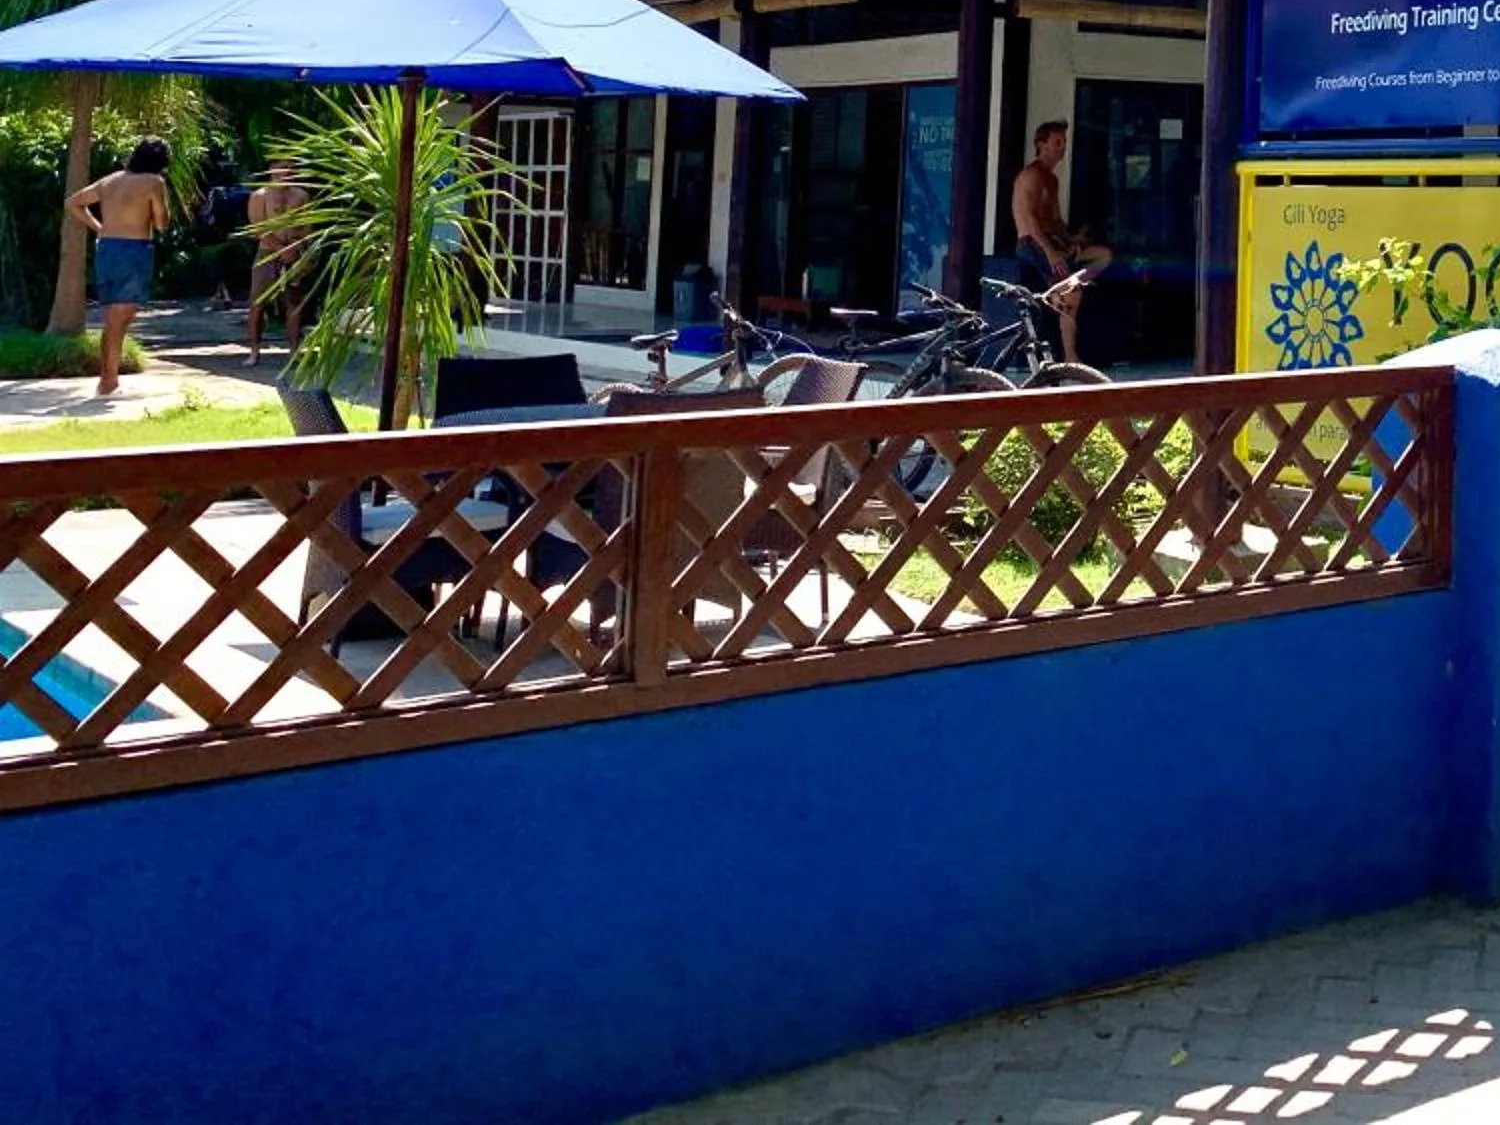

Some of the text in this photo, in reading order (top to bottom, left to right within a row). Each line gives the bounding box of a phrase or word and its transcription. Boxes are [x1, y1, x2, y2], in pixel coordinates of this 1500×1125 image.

[1331, 7, 1408, 36] Freediving
[1411, 1, 1480, 30] Training
[1315, 75, 1367, 92] Freediving
[1368, 72, 1407, 87] Courses
[1409, 70, 1434, 84] from
[1436, 68, 1485, 88] Beginner
[1487, 69, 1500, 82] to
[1308, 203, 1345, 232] Yoga
